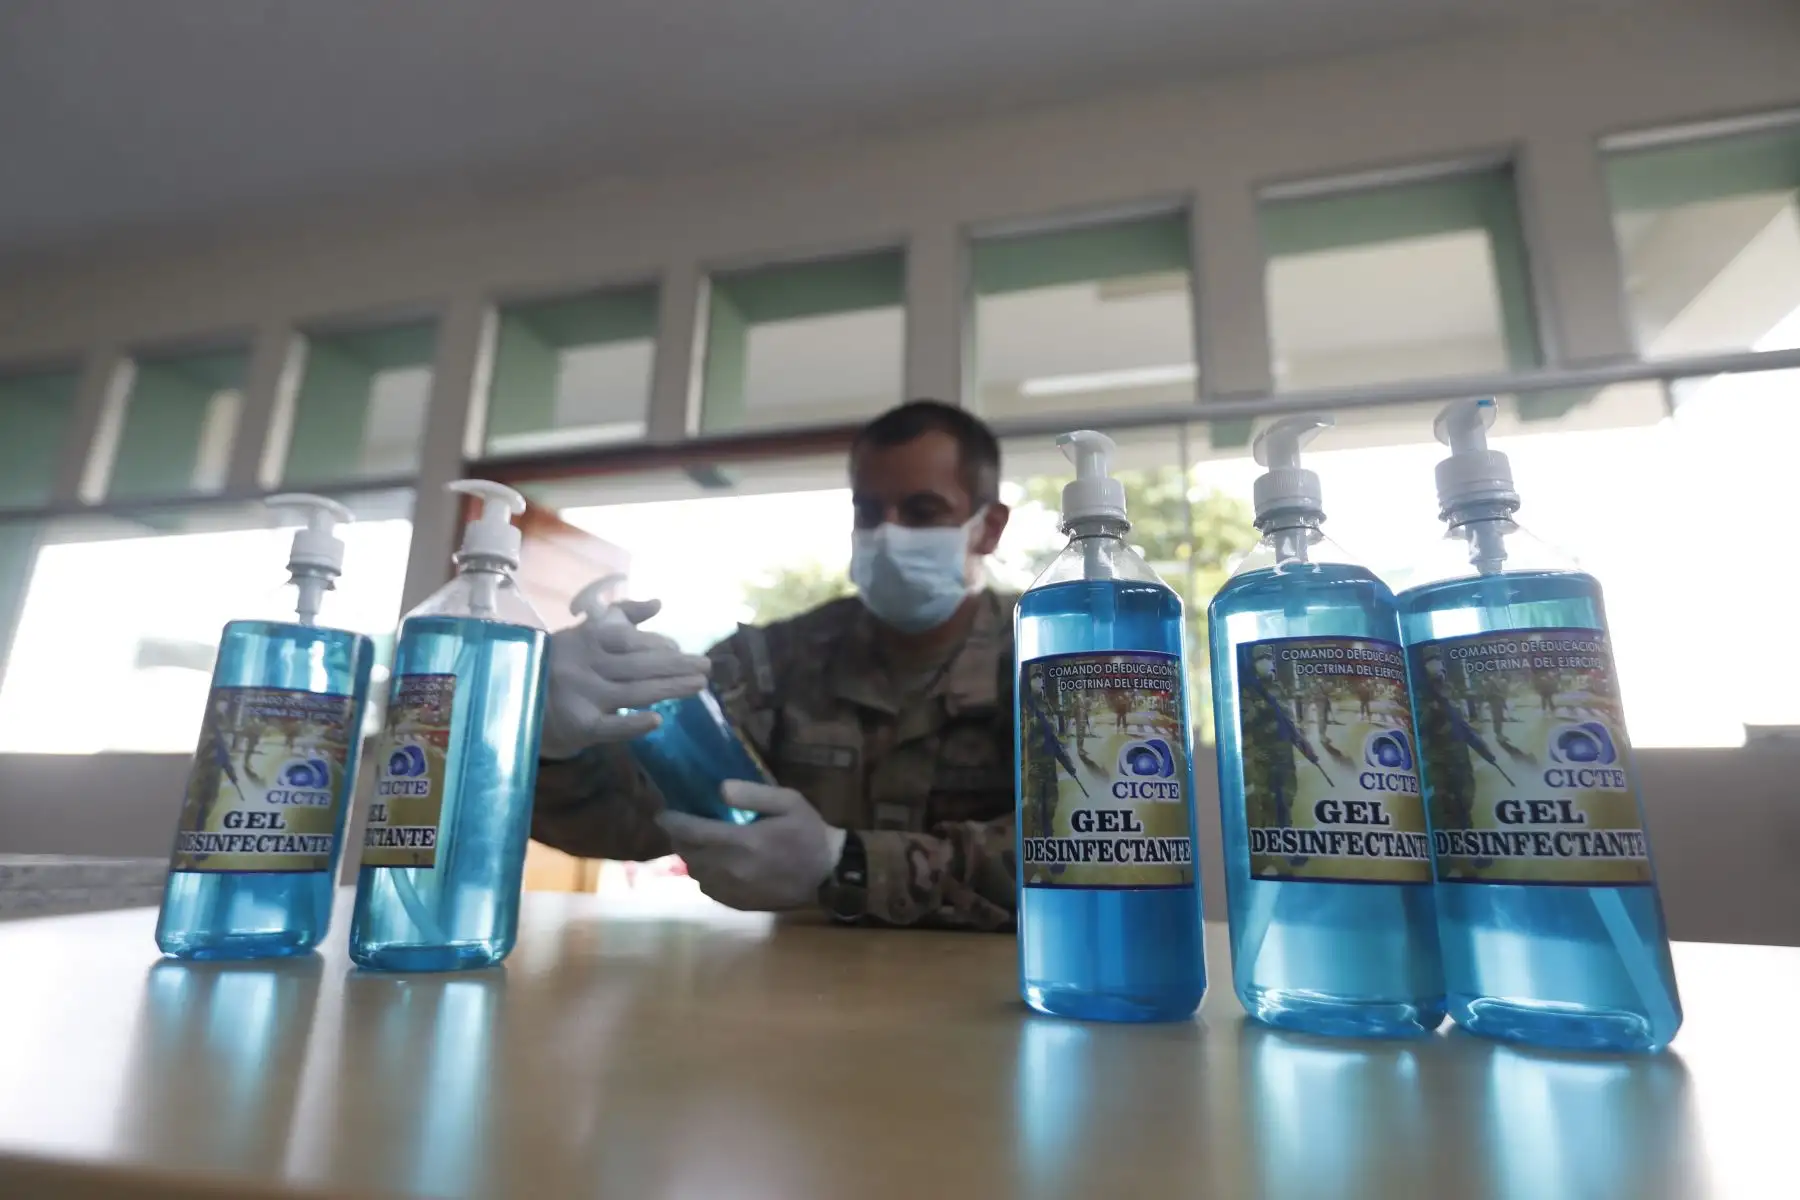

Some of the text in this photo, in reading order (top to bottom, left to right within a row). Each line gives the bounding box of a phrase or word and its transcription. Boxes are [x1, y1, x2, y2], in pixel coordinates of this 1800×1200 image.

[1281, 648, 1344, 661] COMANDO
[1347, 649, 1359, 660] DE
[1449, 642, 1517, 659] COMANDO
[1521, 642, 1537, 653] DE
[1049, 664, 1101, 677] COMANDO
[1105, 663, 1118, 675] DE
[1297, 663, 1353, 676] DOCTRINA
[1357, 664, 1373, 676] DEL
[1467, 657, 1530, 673] DOCTRINA
[1534, 657, 1555, 669] DEL
[1060, 678, 1111, 691] DOCTRINA
[1114, 678, 1131, 688] DEL
[1359, 772, 1418, 793] CICTE
[1544, 768, 1625, 789] CICTE
[266, 790, 331, 805] CICTE
[1112, 781, 1179, 799] CICTE
[223, 810, 286, 829] GEL
[1071, 809, 1142, 832] GEL
[1314, 799, 1390, 825] GEL
[1495, 799, 1585, 825] GEL
[1024, 838, 1191, 863] DESINFECTANTE
[1434, 831, 1647, 858] DESINFECTANTE
